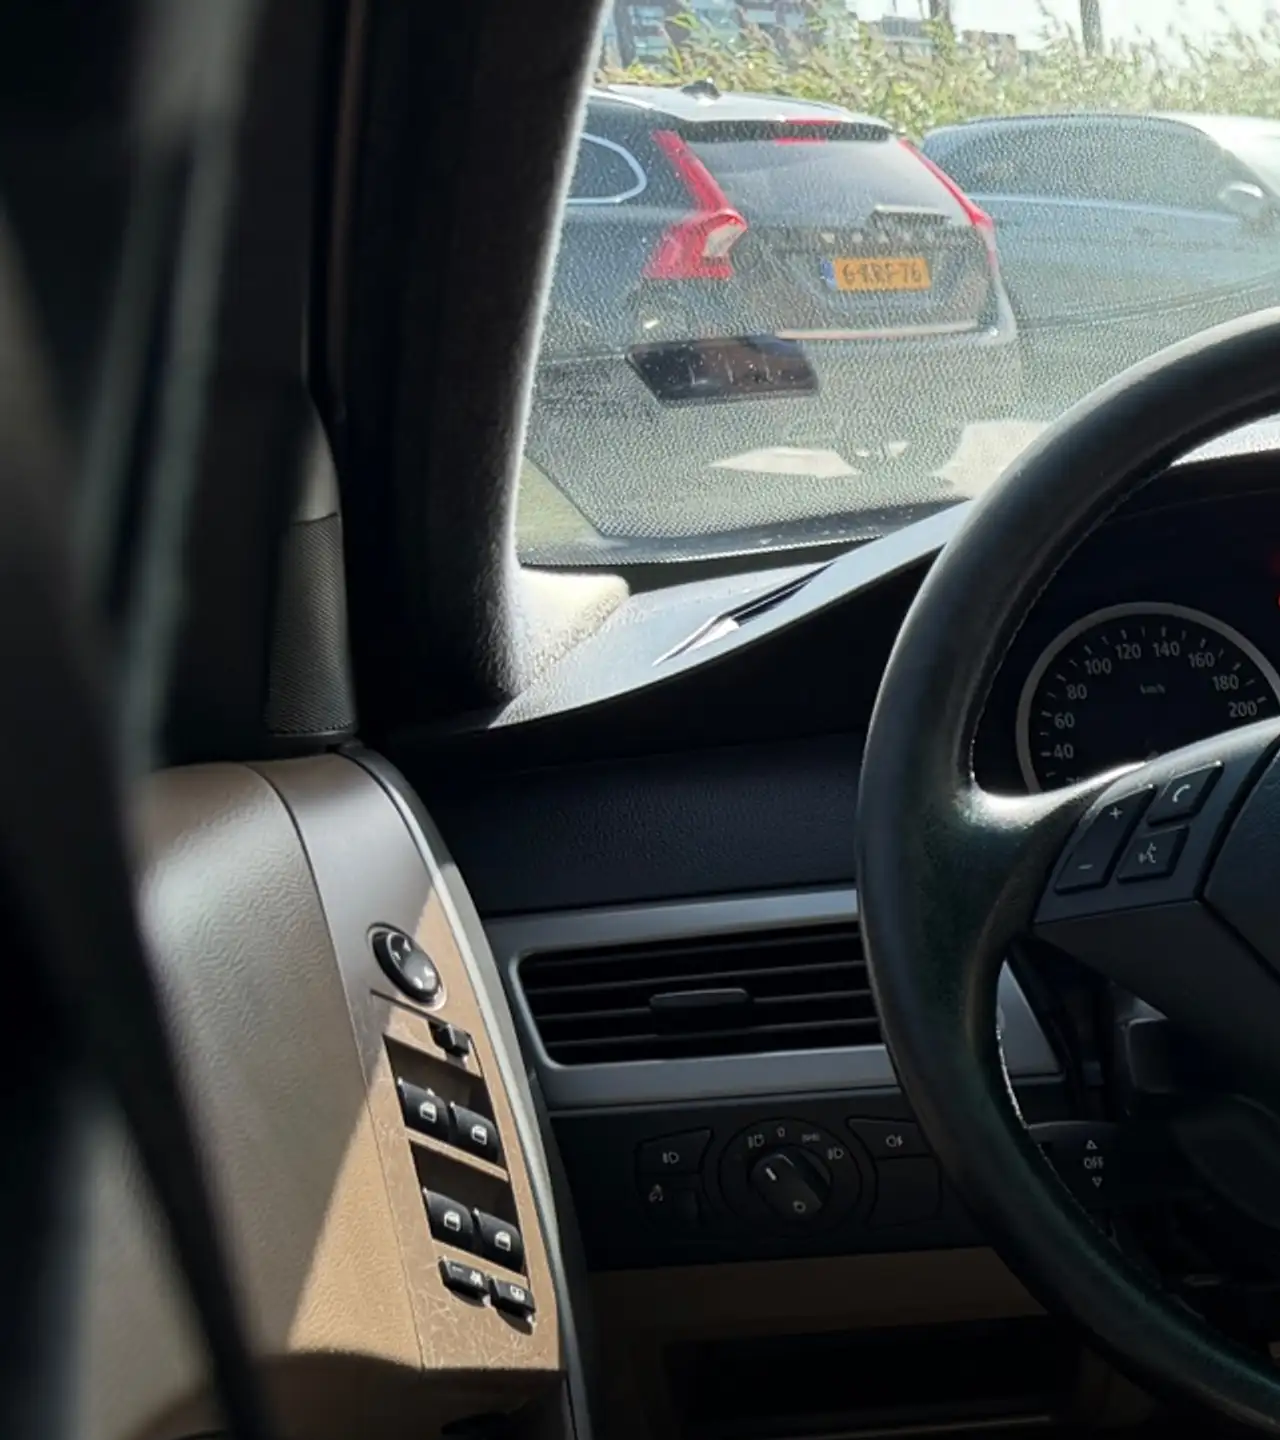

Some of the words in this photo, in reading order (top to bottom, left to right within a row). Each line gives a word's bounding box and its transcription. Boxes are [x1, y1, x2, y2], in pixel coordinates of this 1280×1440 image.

[1114, 643, 1142, 661] 120
[1151, 641, 1181, 658] 140
[1083, 657, 1113, 676] 100
[1187, 651, 1216, 668] 160
[1211, 673, 1240, 692] 180
[1065, 683, 1088, 701] 80
[1227, 700, 1259, 718] 200
[1053, 711, 1076, 730] 60
[1052, 743, 1074, 760] 40
[1083, 1155, 1105, 1170] OFF
